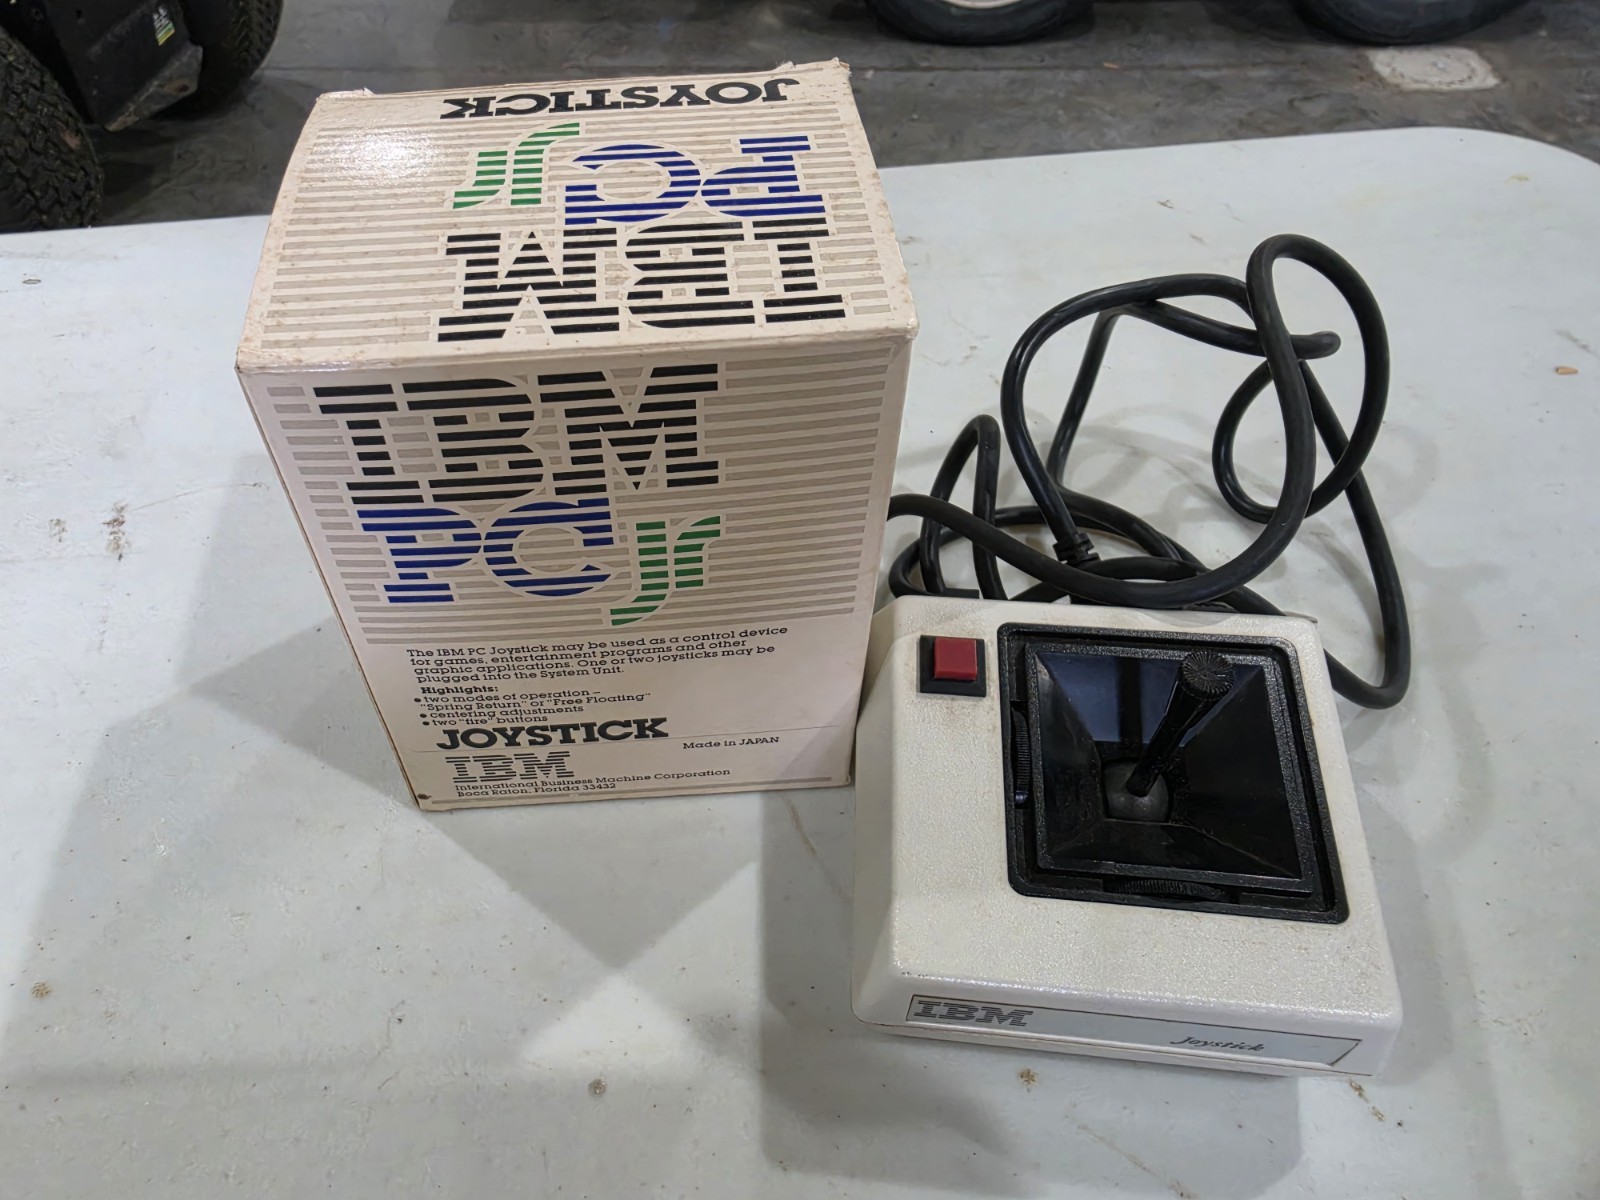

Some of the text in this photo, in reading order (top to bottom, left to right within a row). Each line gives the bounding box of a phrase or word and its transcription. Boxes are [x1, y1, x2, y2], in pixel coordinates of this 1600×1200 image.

[439, 78, 800, 120] JOYSTICK
[438, 217, 846, 342] IBM
[313, 363, 719, 504] IBM
[406, 649, 434, 657] The
[437, 648, 464, 657] IBM
[468, 647, 486, 656] PC
[489, 644, 549, 655] Joystick
[552, 643, 585, 652] may
[588, 640, 607, 649] be
[610, 638, 645, 648] used
[649, 636, 666, 645] as
[683, 631, 735, 642] control
[739, 627, 788, 638] device
[410, 657, 431, 666] for
[491, 650, 597, 664] entertainment
[600, 645, 673, 658] programs
[675, 642, 705, 651] and
[708, 639, 747, 649] other
[414, 645, 775, 675] graphic applications. One or two joysticks may be
[417, 666, 624, 684] plugged into the System Unit.
[421, 685, 499, 695] Highlights:
[452, 694, 500, 703] modes
[503, 692, 517, 700] of
[520, 689, 590, 700] operation
[430, 705, 584, 719] centering adjustments
[496, 714, 548, 723] buttons
[436, 717, 669, 750] JOYSTICK
[682, 736, 780, 750] Made in JAPAN
[445, 751, 575, 784] IBM
[455, 769, 730, 792] International Business Machine Corporation
[535, 785, 580, 793] Florida
[582, 783, 616, 791] 33432
[913, 1000, 1034, 1027] IBM
[1170, 1036, 1264, 1052] Joystick
